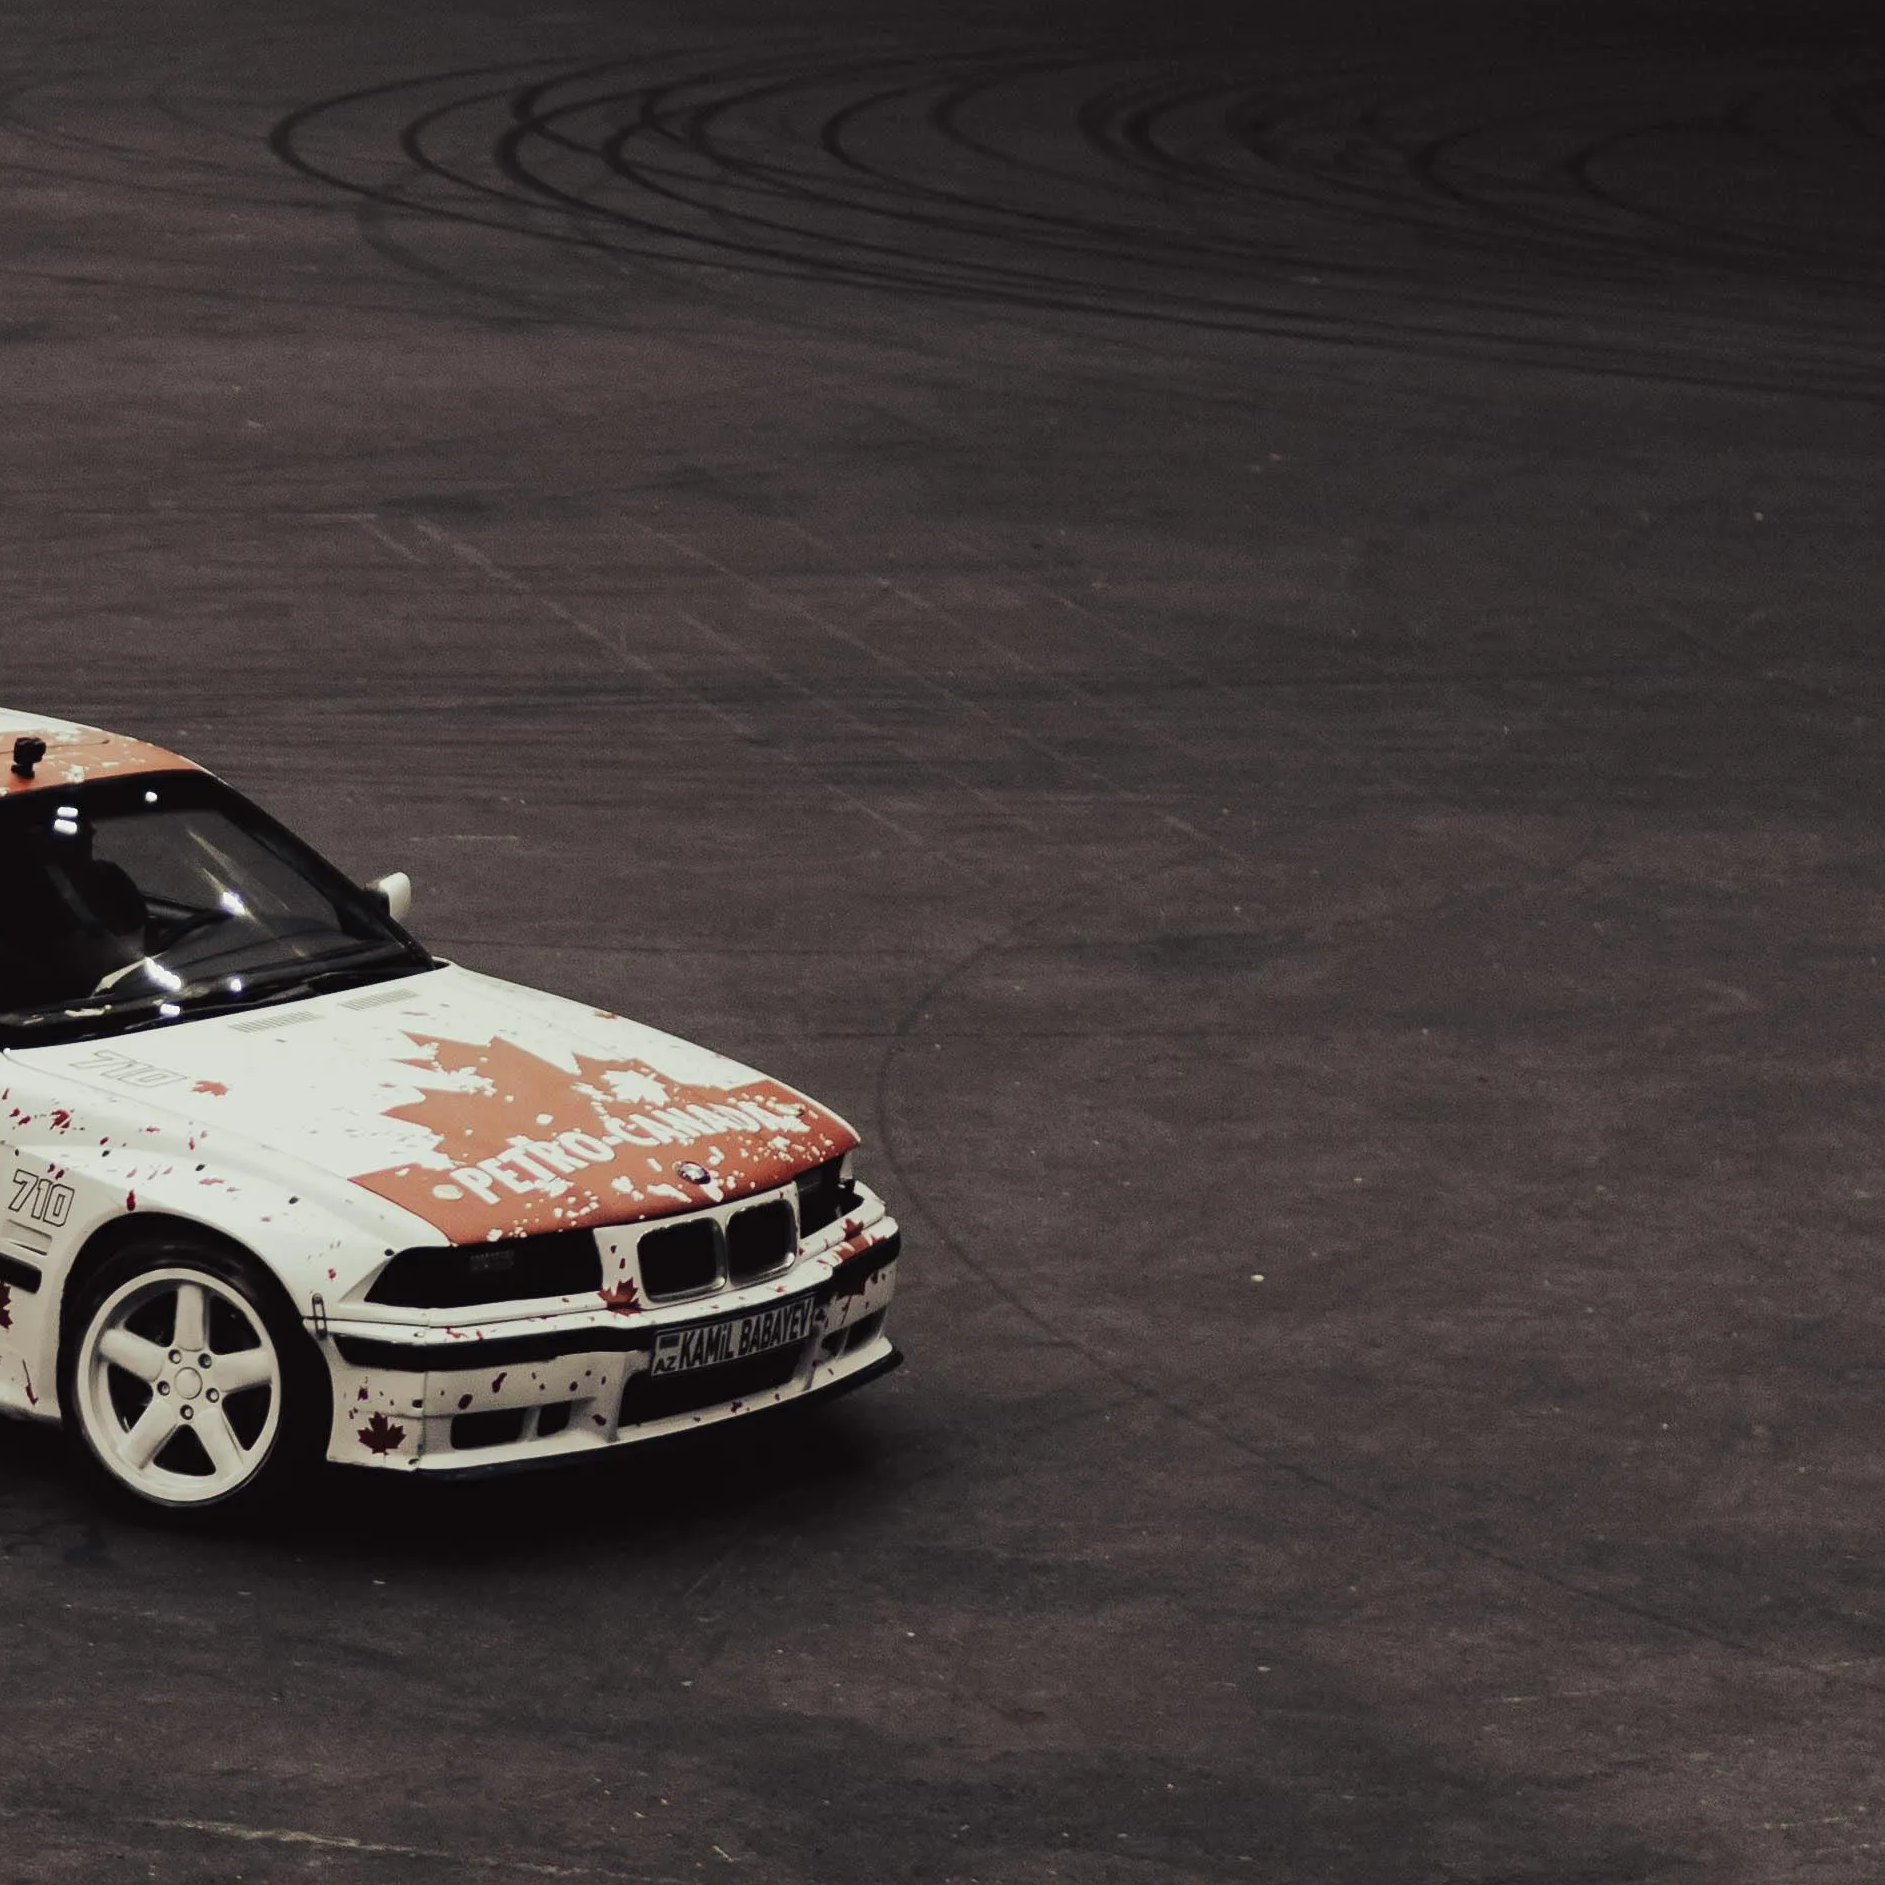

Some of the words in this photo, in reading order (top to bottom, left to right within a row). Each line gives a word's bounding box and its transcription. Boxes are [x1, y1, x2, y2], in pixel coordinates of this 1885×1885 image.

[67, 1049, 189, 1088] 710
[8, 1167, 76, 1227] 710
[737, 1297, 815, 1355] BABAYEV
[653, 1355, 677, 1374] AZ
